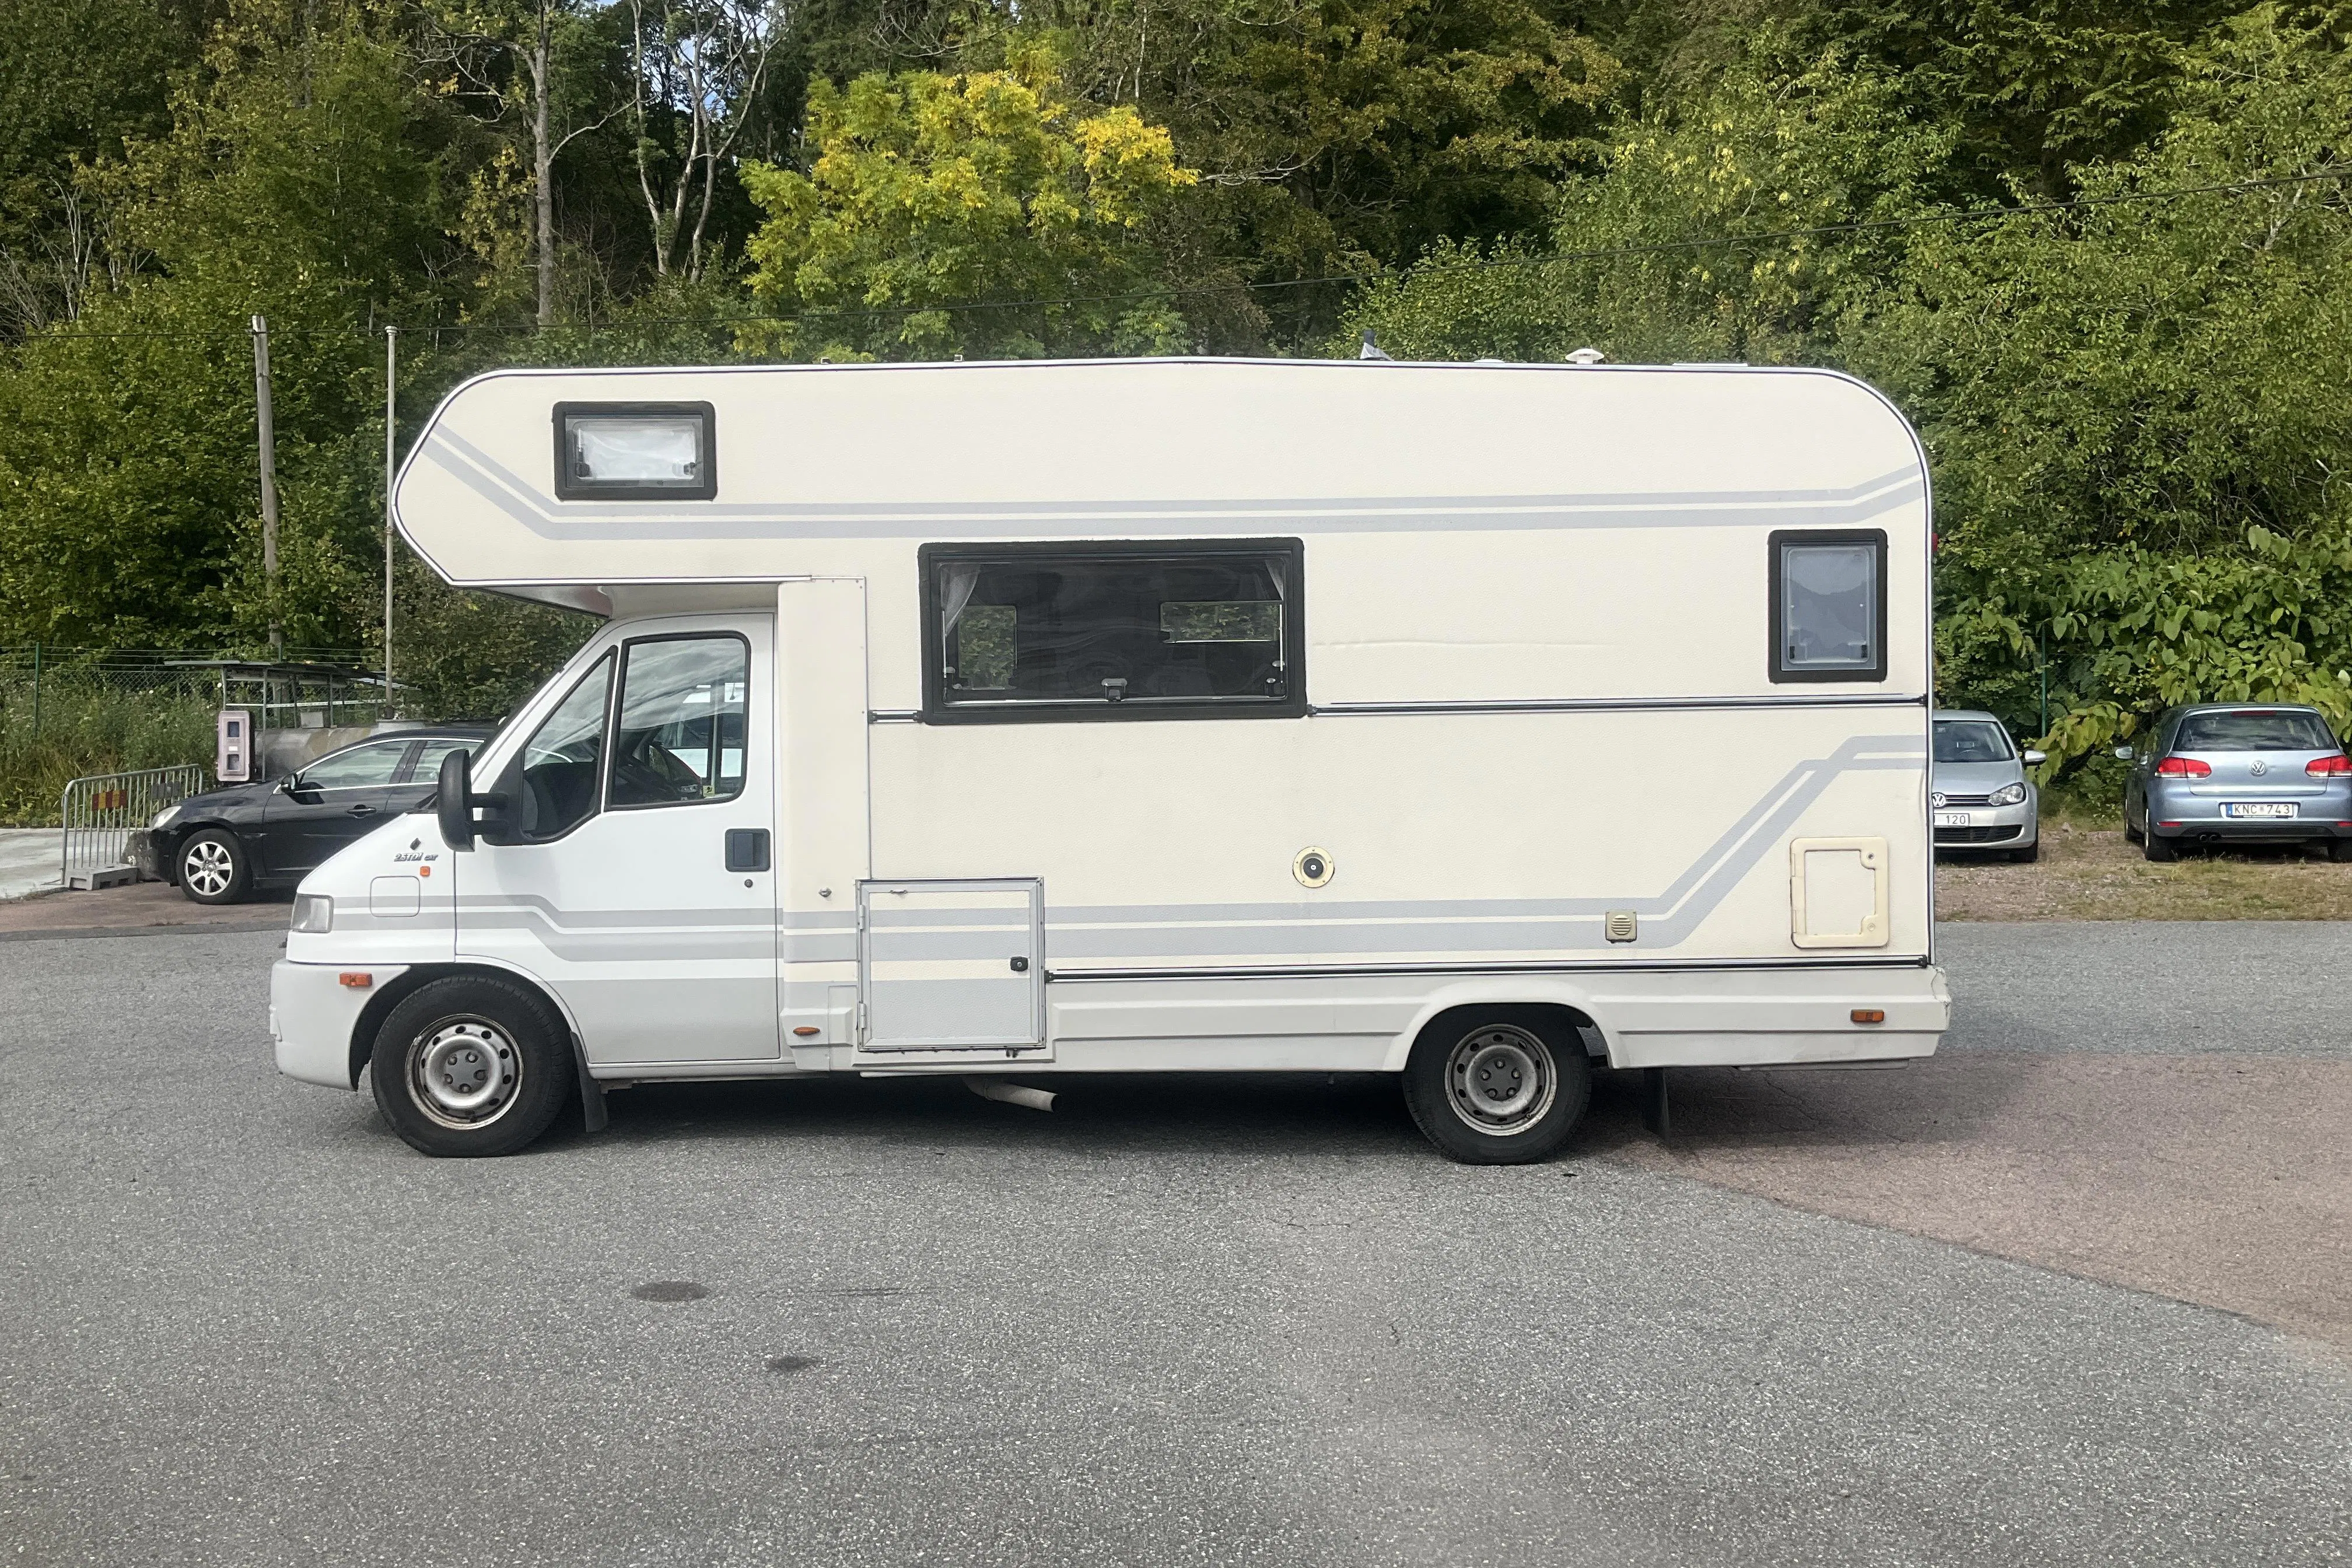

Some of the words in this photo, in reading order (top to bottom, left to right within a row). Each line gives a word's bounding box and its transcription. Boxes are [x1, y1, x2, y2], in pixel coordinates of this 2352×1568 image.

[2234, 804, 2257, 814] KNC
[2267, 804, 2290, 814] 743
[1945, 815, 1966, 824] 120
